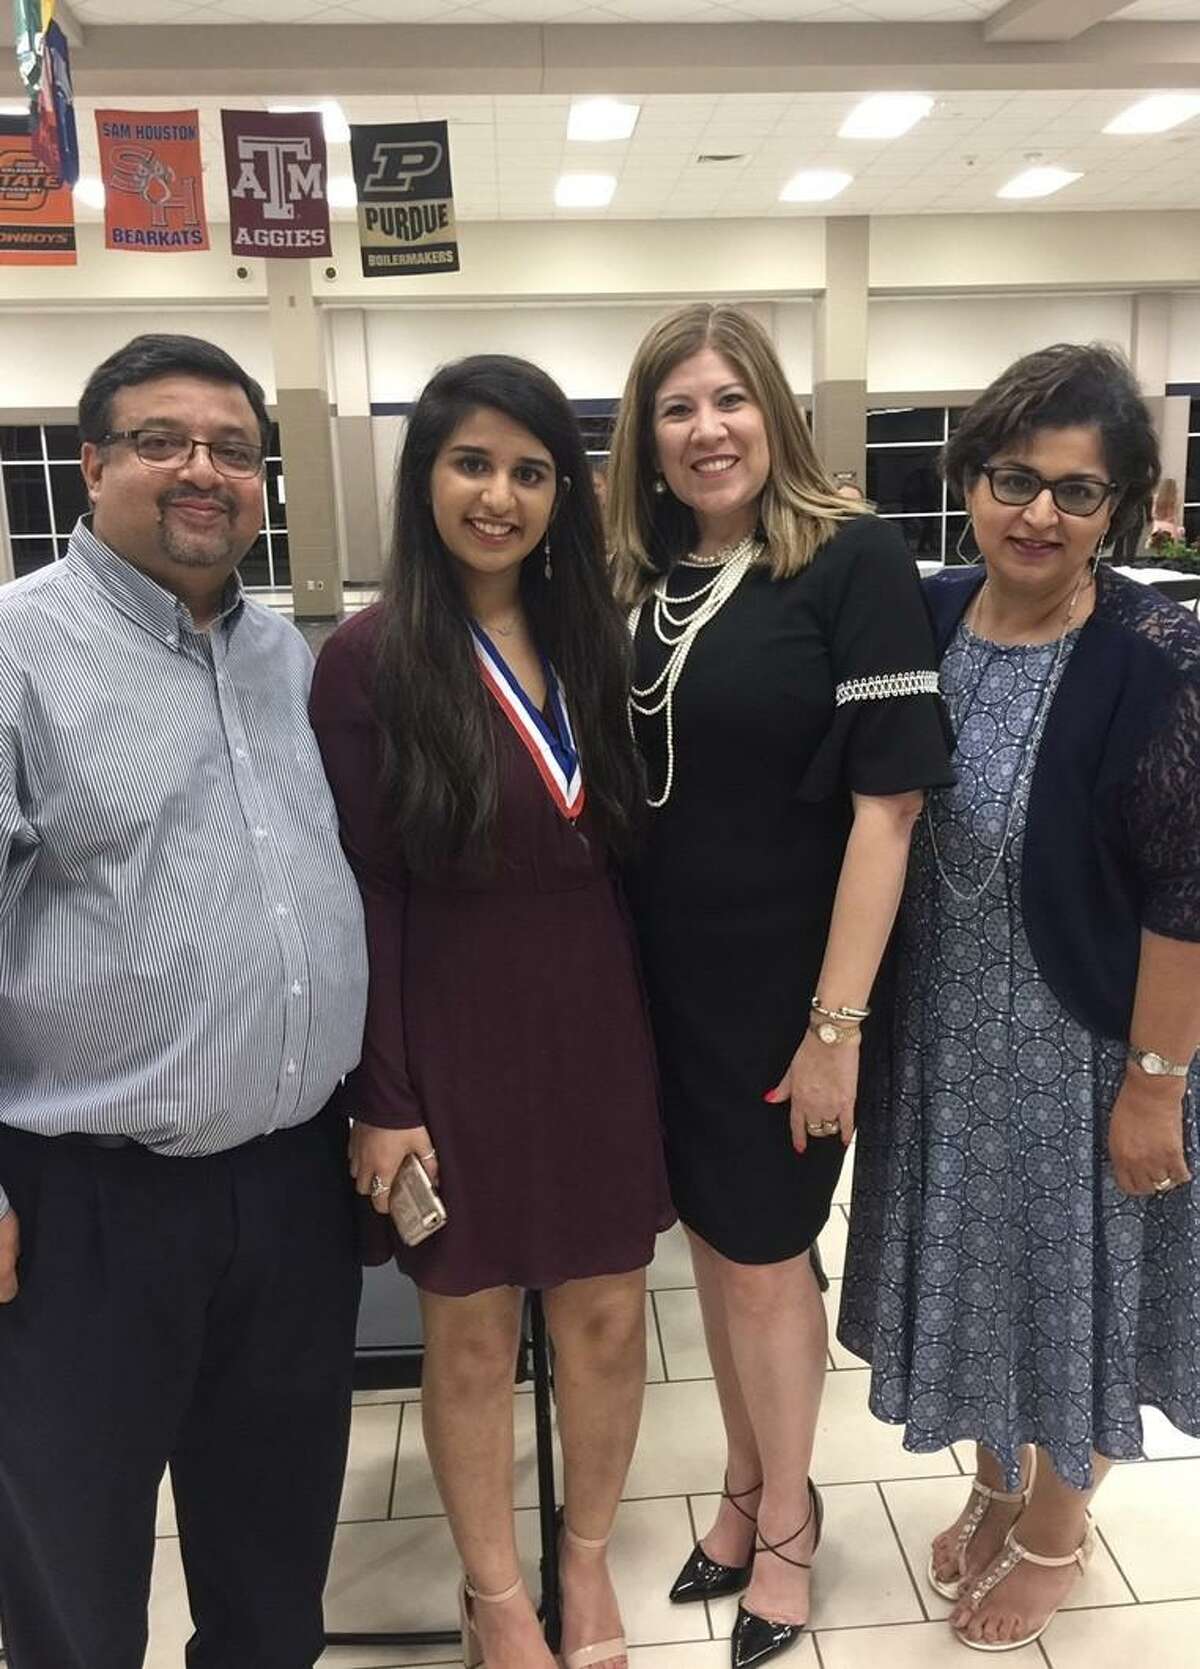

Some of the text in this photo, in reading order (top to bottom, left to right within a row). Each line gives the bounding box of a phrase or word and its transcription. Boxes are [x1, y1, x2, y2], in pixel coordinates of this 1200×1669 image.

[103, 123, 196, 140] SAM HOUSTON
[363, 141, 442, 192] P
[365, 203, 449, 242] PURDUE
[112, 227, 203, 246] BEARKATS
[235, 227, 326, 247] AGGIES
[367, 250, 454, 267] BOILERMAKERS
